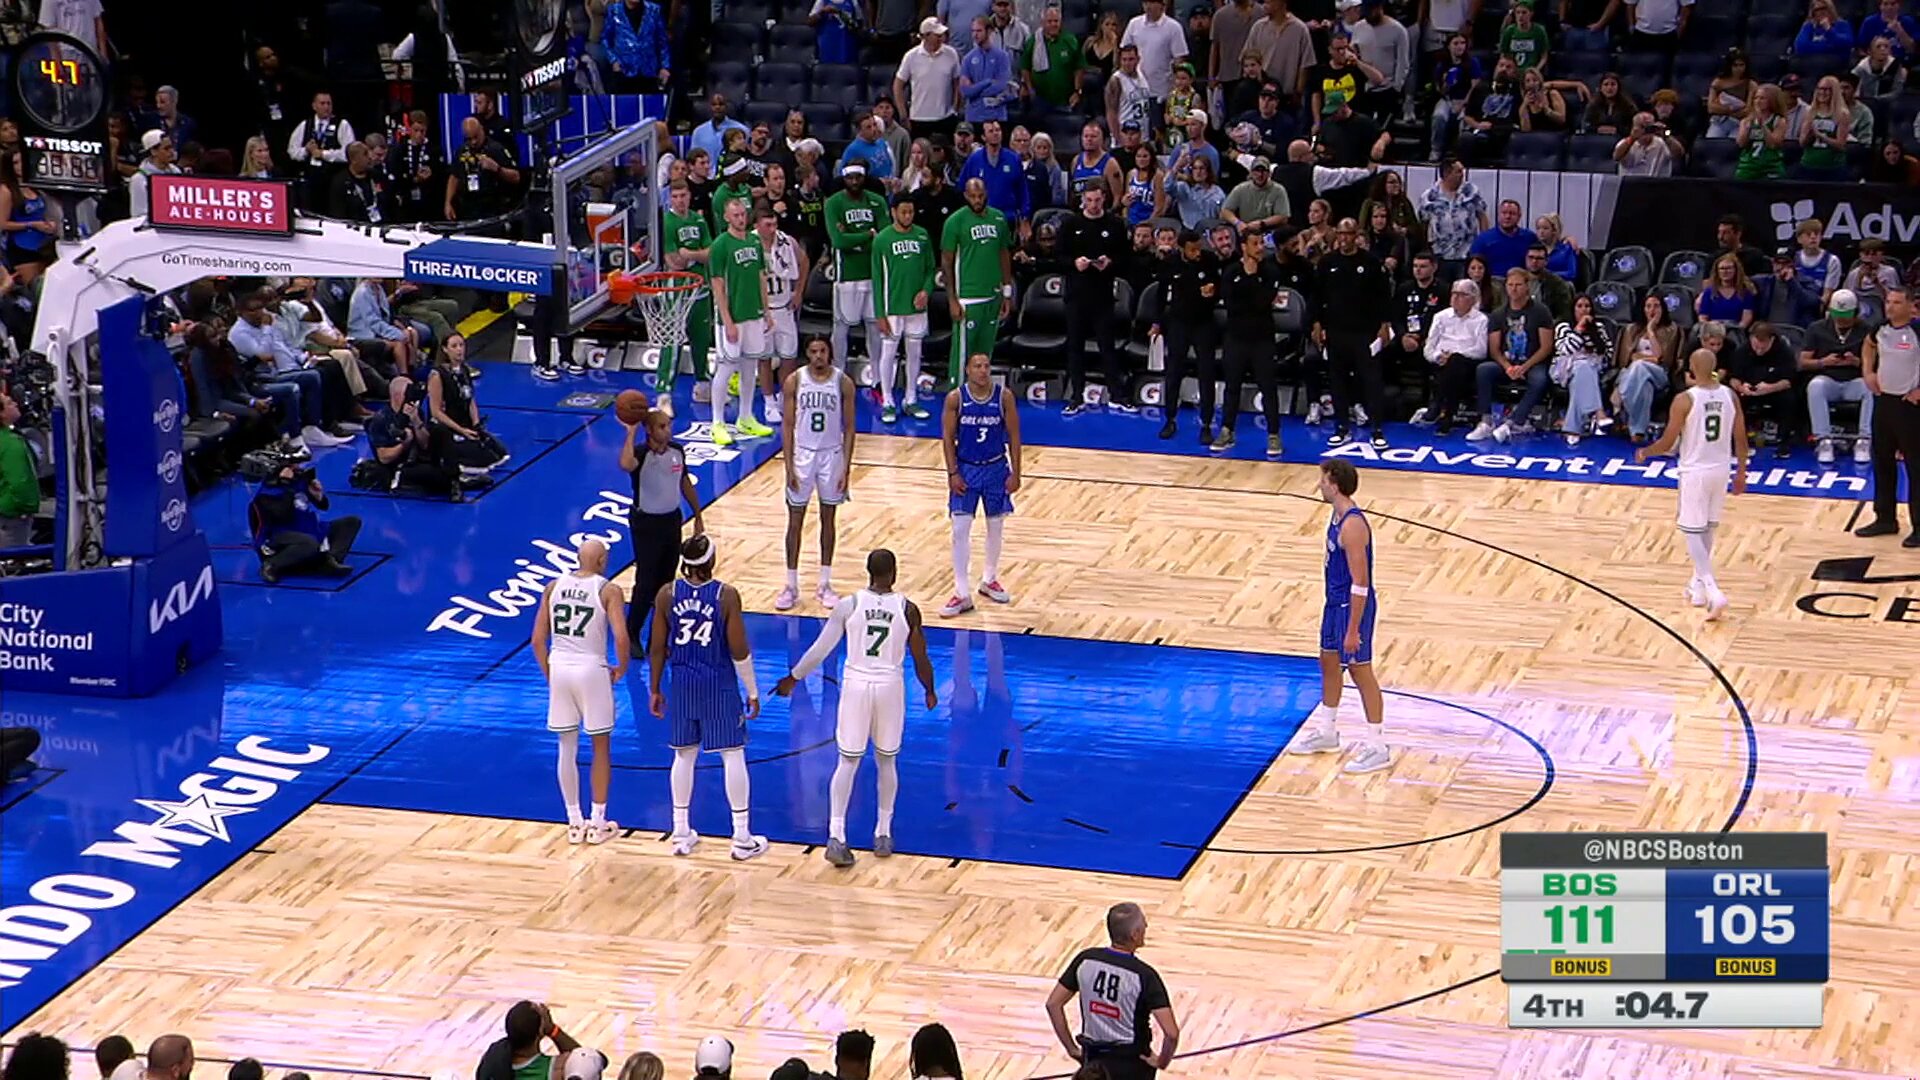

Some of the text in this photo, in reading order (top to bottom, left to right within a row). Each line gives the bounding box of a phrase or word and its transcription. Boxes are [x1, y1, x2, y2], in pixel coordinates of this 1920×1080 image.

[40, 60, 78, 85] 4.7
[533, 57, 566, 86] TISSOT
[45, 137, 102, 154] TISSOT
[168, 185, 274, 209] MILLER'S
[162, 252, 292, 273] GoTimesharing.com
[409, 260, 538, 286] THREATLOCKER
[1046, 277, 1061, 294] G
[587, 348, 607, 369] G
[800, 391, 837, 411] CELTICS
[1140, 383, 1160, 404] G
[811, 412, 825, 432] 8
[1705, 415, 1720, 442] 9
[976, 427, 989, 442] 3
[0, 603, 44, 629] City
[553, 604, 594, 637] 27
[0, 627, 93, 650] National
[675, 619, 713, 647] 34
[866, 625, 889, 656] 7
[0, 650, 55, 672] Bank
[1093, 970, 1120, 1003] 48
